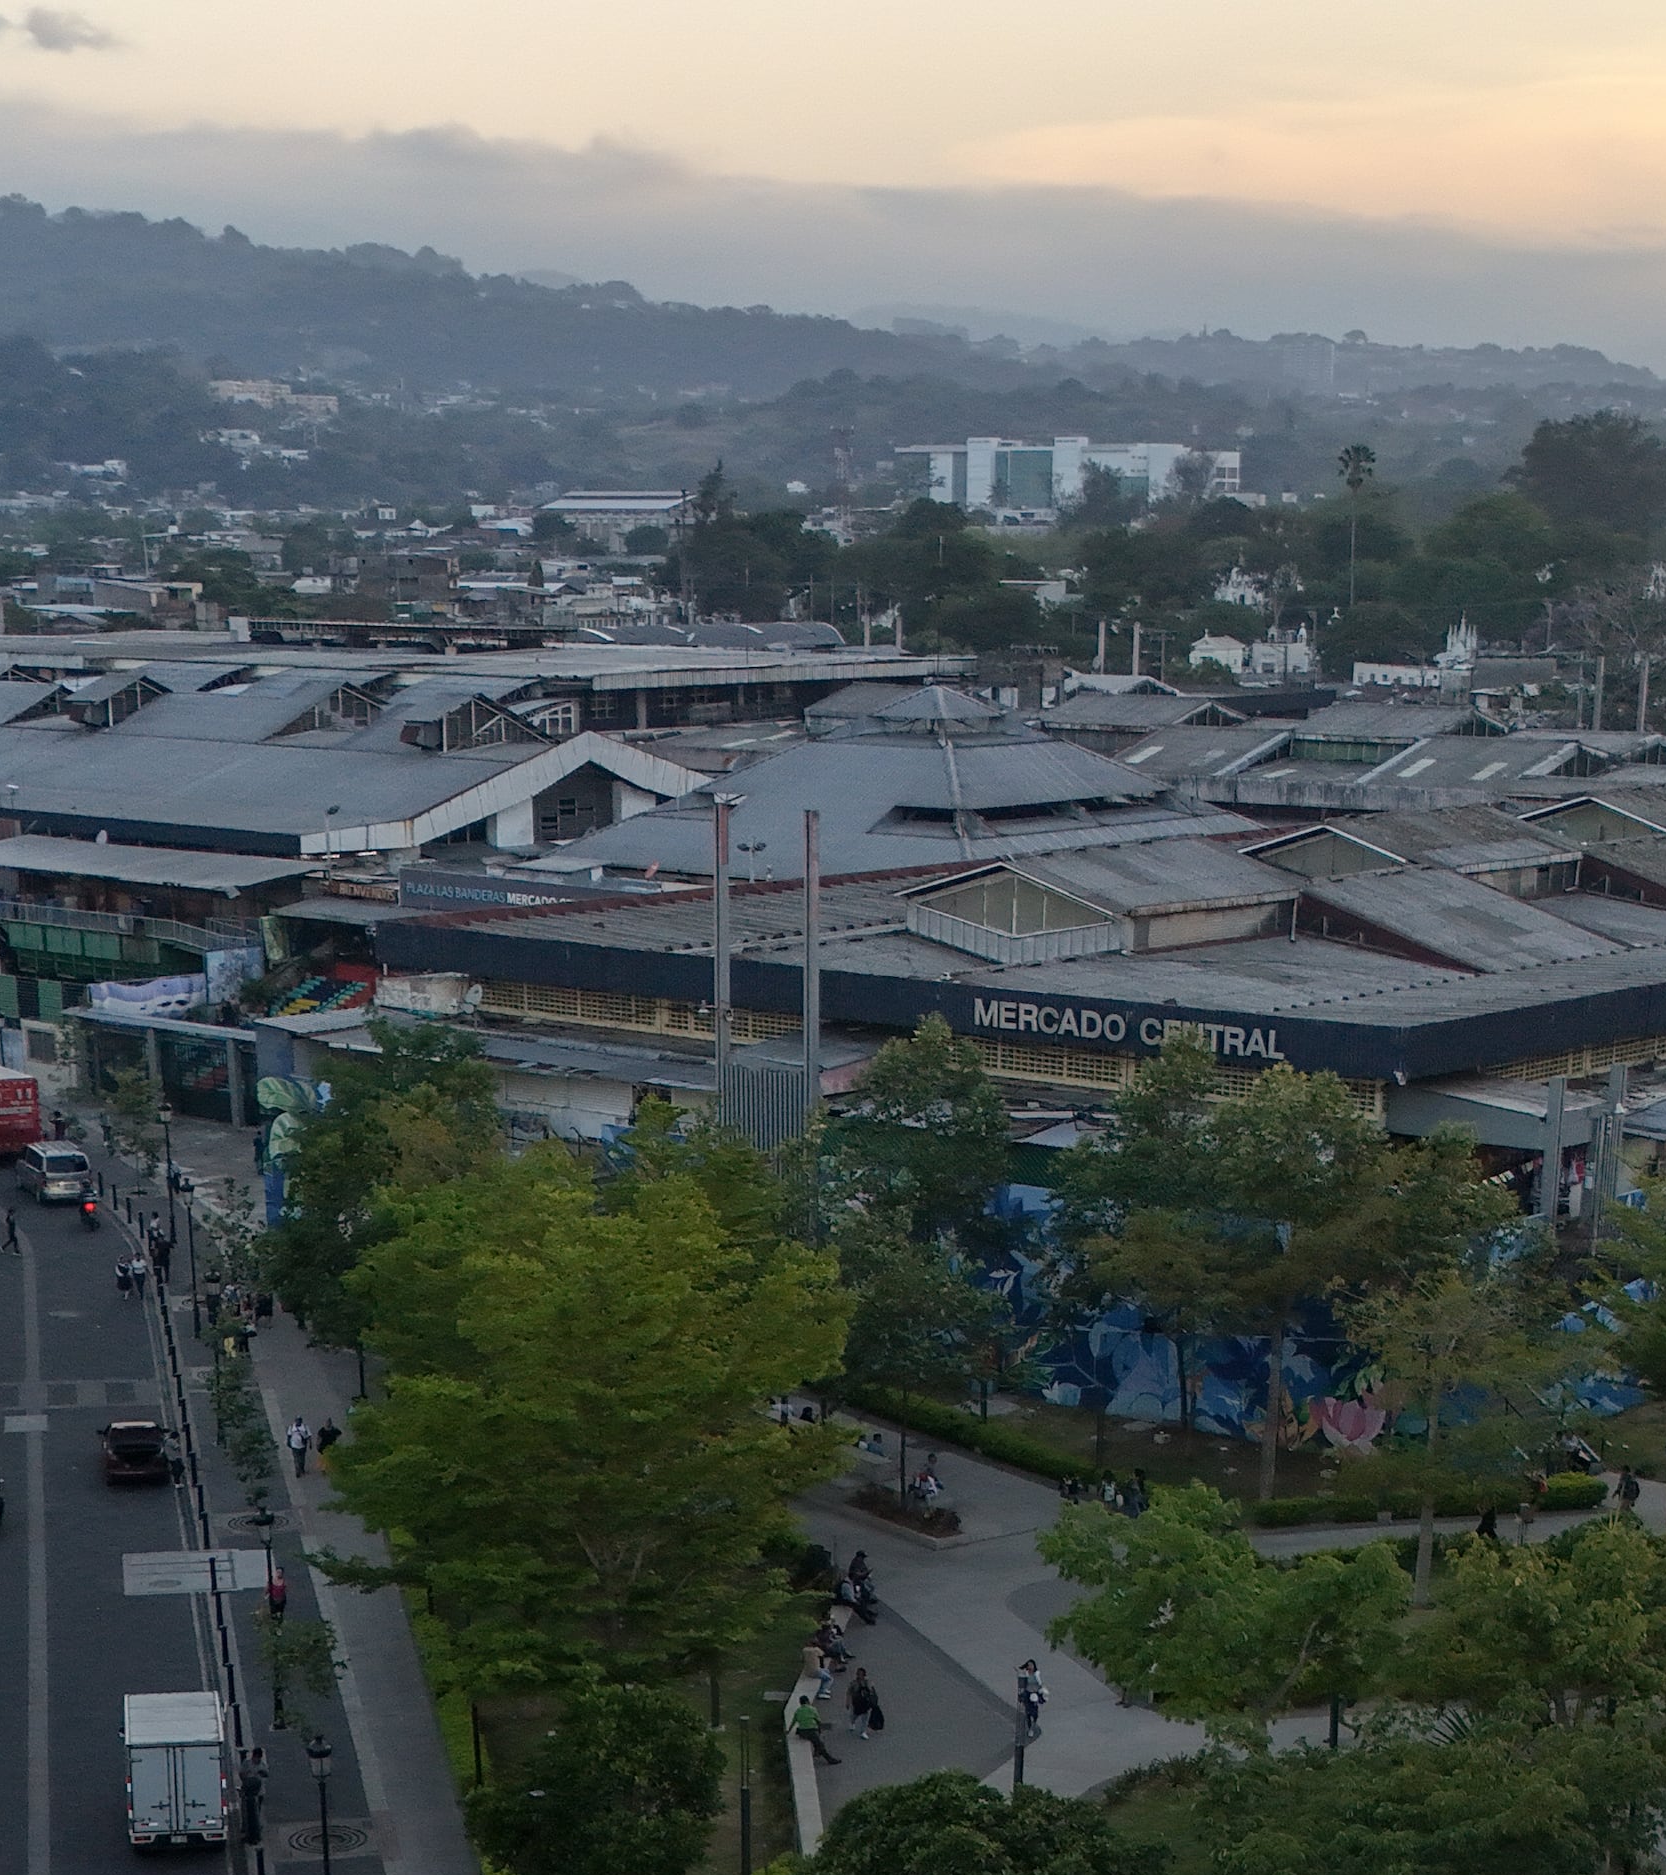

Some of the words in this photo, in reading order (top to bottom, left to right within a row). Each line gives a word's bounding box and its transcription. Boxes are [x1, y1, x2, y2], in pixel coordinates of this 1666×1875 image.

[406, 882, 434, 896] PLAZA
[435, 886, 454, 898] LAS
[455, 888, 506, 904] BANDERAS
[974, 998, 1126, 1041] MERCADO
